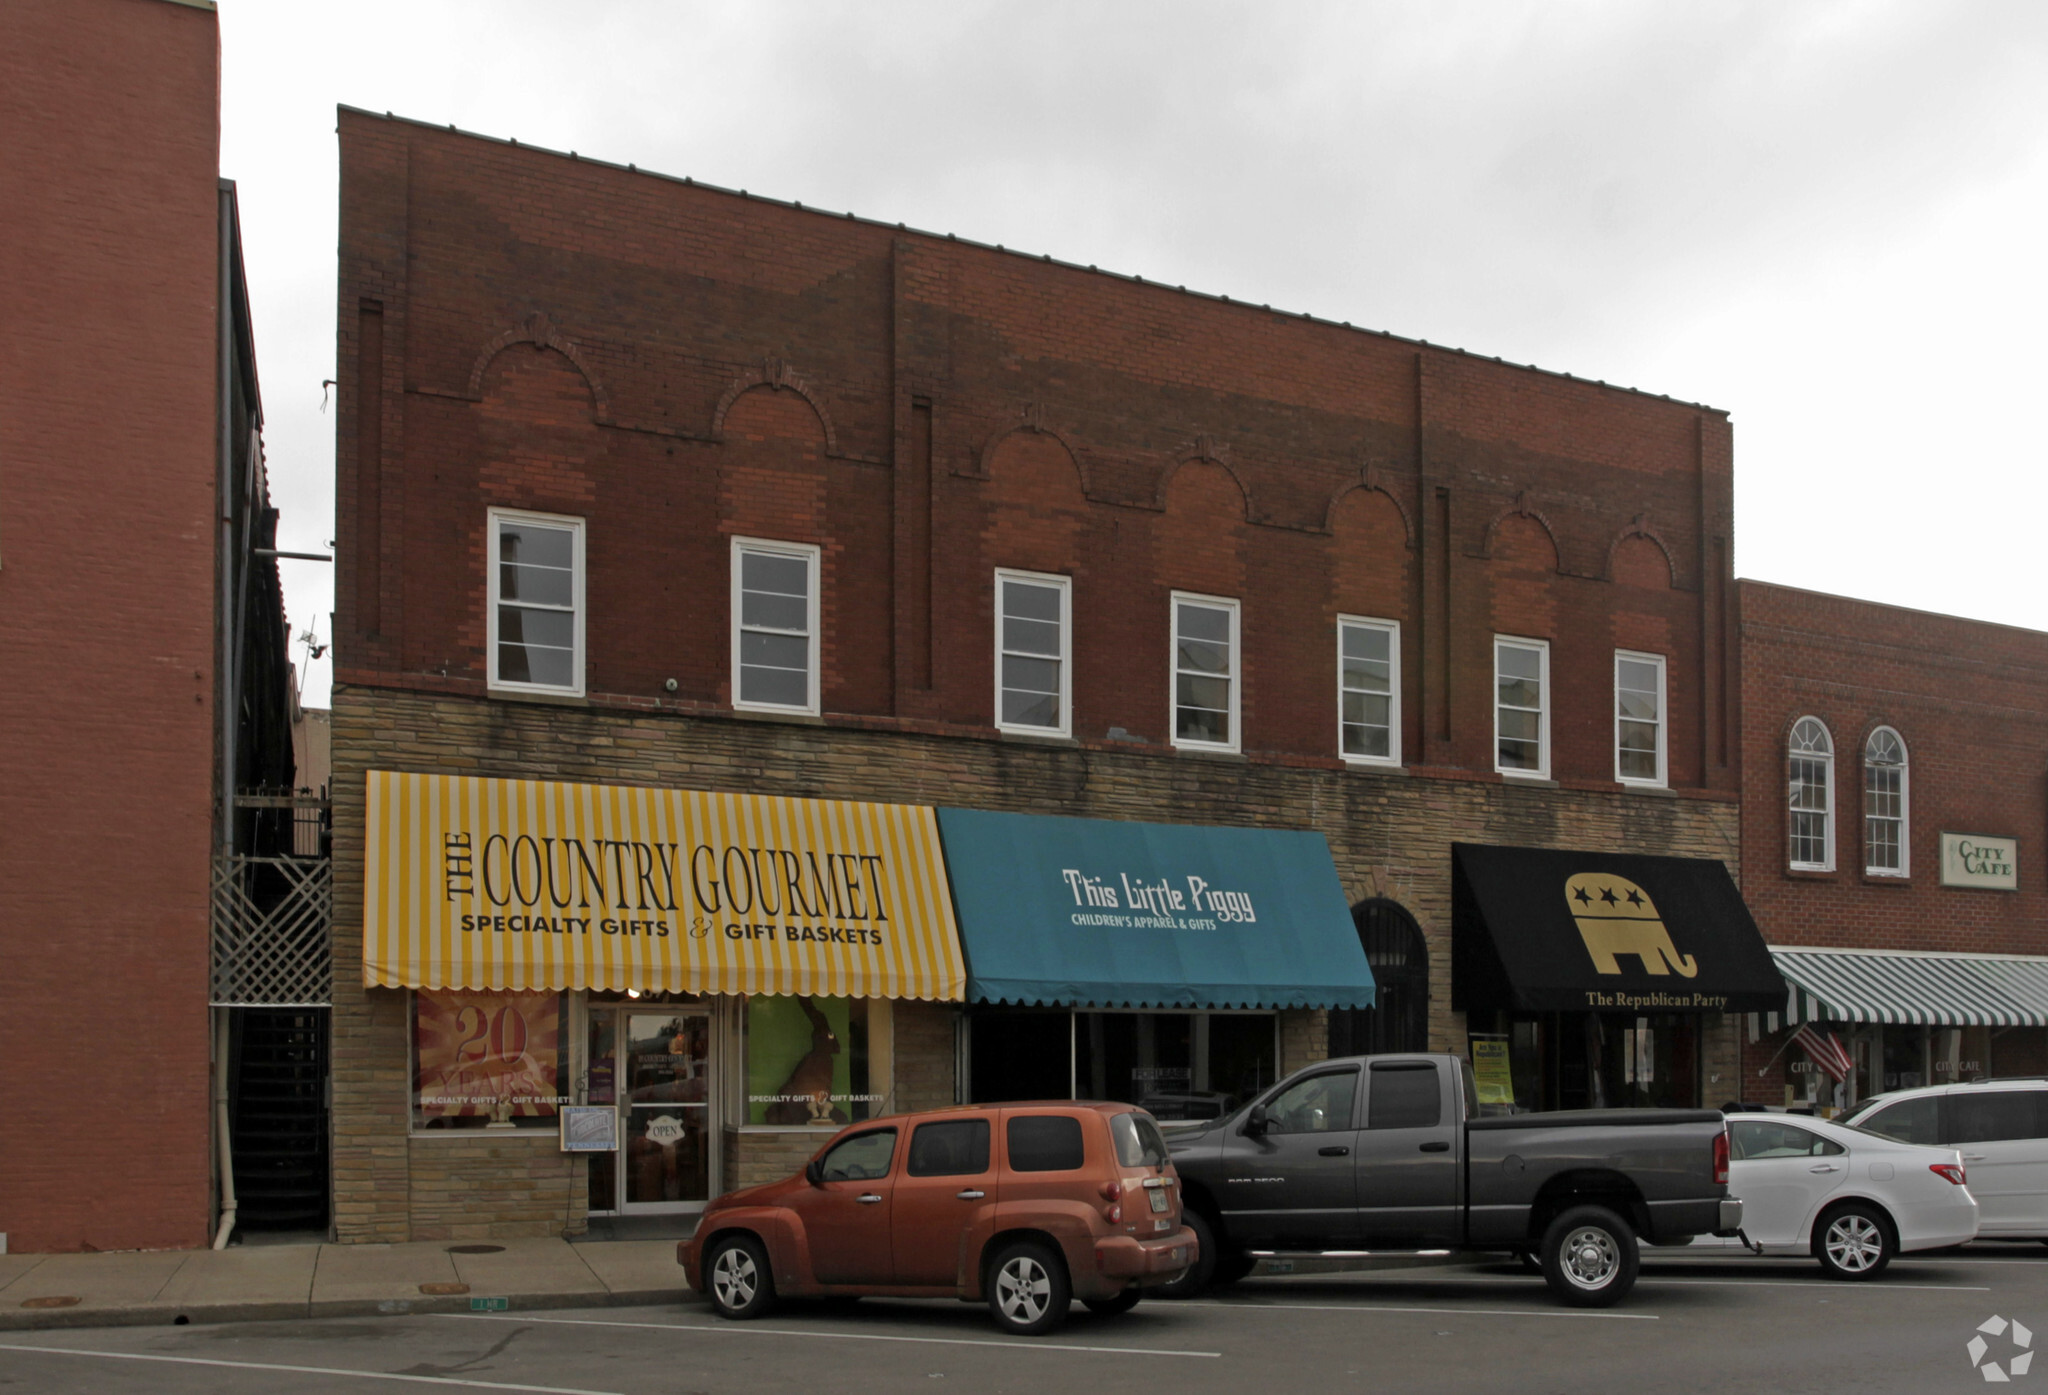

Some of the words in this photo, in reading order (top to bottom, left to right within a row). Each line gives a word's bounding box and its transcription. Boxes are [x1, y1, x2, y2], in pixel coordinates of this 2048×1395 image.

[444, 832, 474, 902] THE
[482, 833, 681, 912] COUNTRY
[691, 844, 890, 922] GOURMET
[1062, 869, 1119, 908] This
[1120, 872, 1187, 917] Little
[1187, 875, 1257, 923] Piggy
[461, 914, 591, 935] SPECIALTY
[599, 918, 670, 938] GIFTS
[690, 916, 713, 939] &
[725, 923, 777, 942] GIFT
[785, 926, 883, 946] BASKETS
[1072, 913, 1132, 928] CHILDREN'S
[1134, 916, 1178, 930] APPAREL
[1179, 918, 1188, 930] &
[1189, 919, 1217, 931] GIFTS
[1585, 991, 1613, 1006] The
[1616, 991, 1690, 1011] Republican
[1693, 992, 1728, 1010] Party
[455, 1005, 529, 1065] 20
[1791, 1062, 1813, 1073] CITY
[439, 1070, 535, 1095] YEARS
[420, 1096, 469, 1104] SPECIALTY
[471, 1096, 497, 1104] GIFTS
[512, 1096, 532, 1104] GIFT
[534, 1096, 574, 1104] BASKETS
[830, 1094, 847, 1102] GIFT
[849, 1094, 884, 1102] BASKETS
[652, 1125, 678, 1137] OPEN
